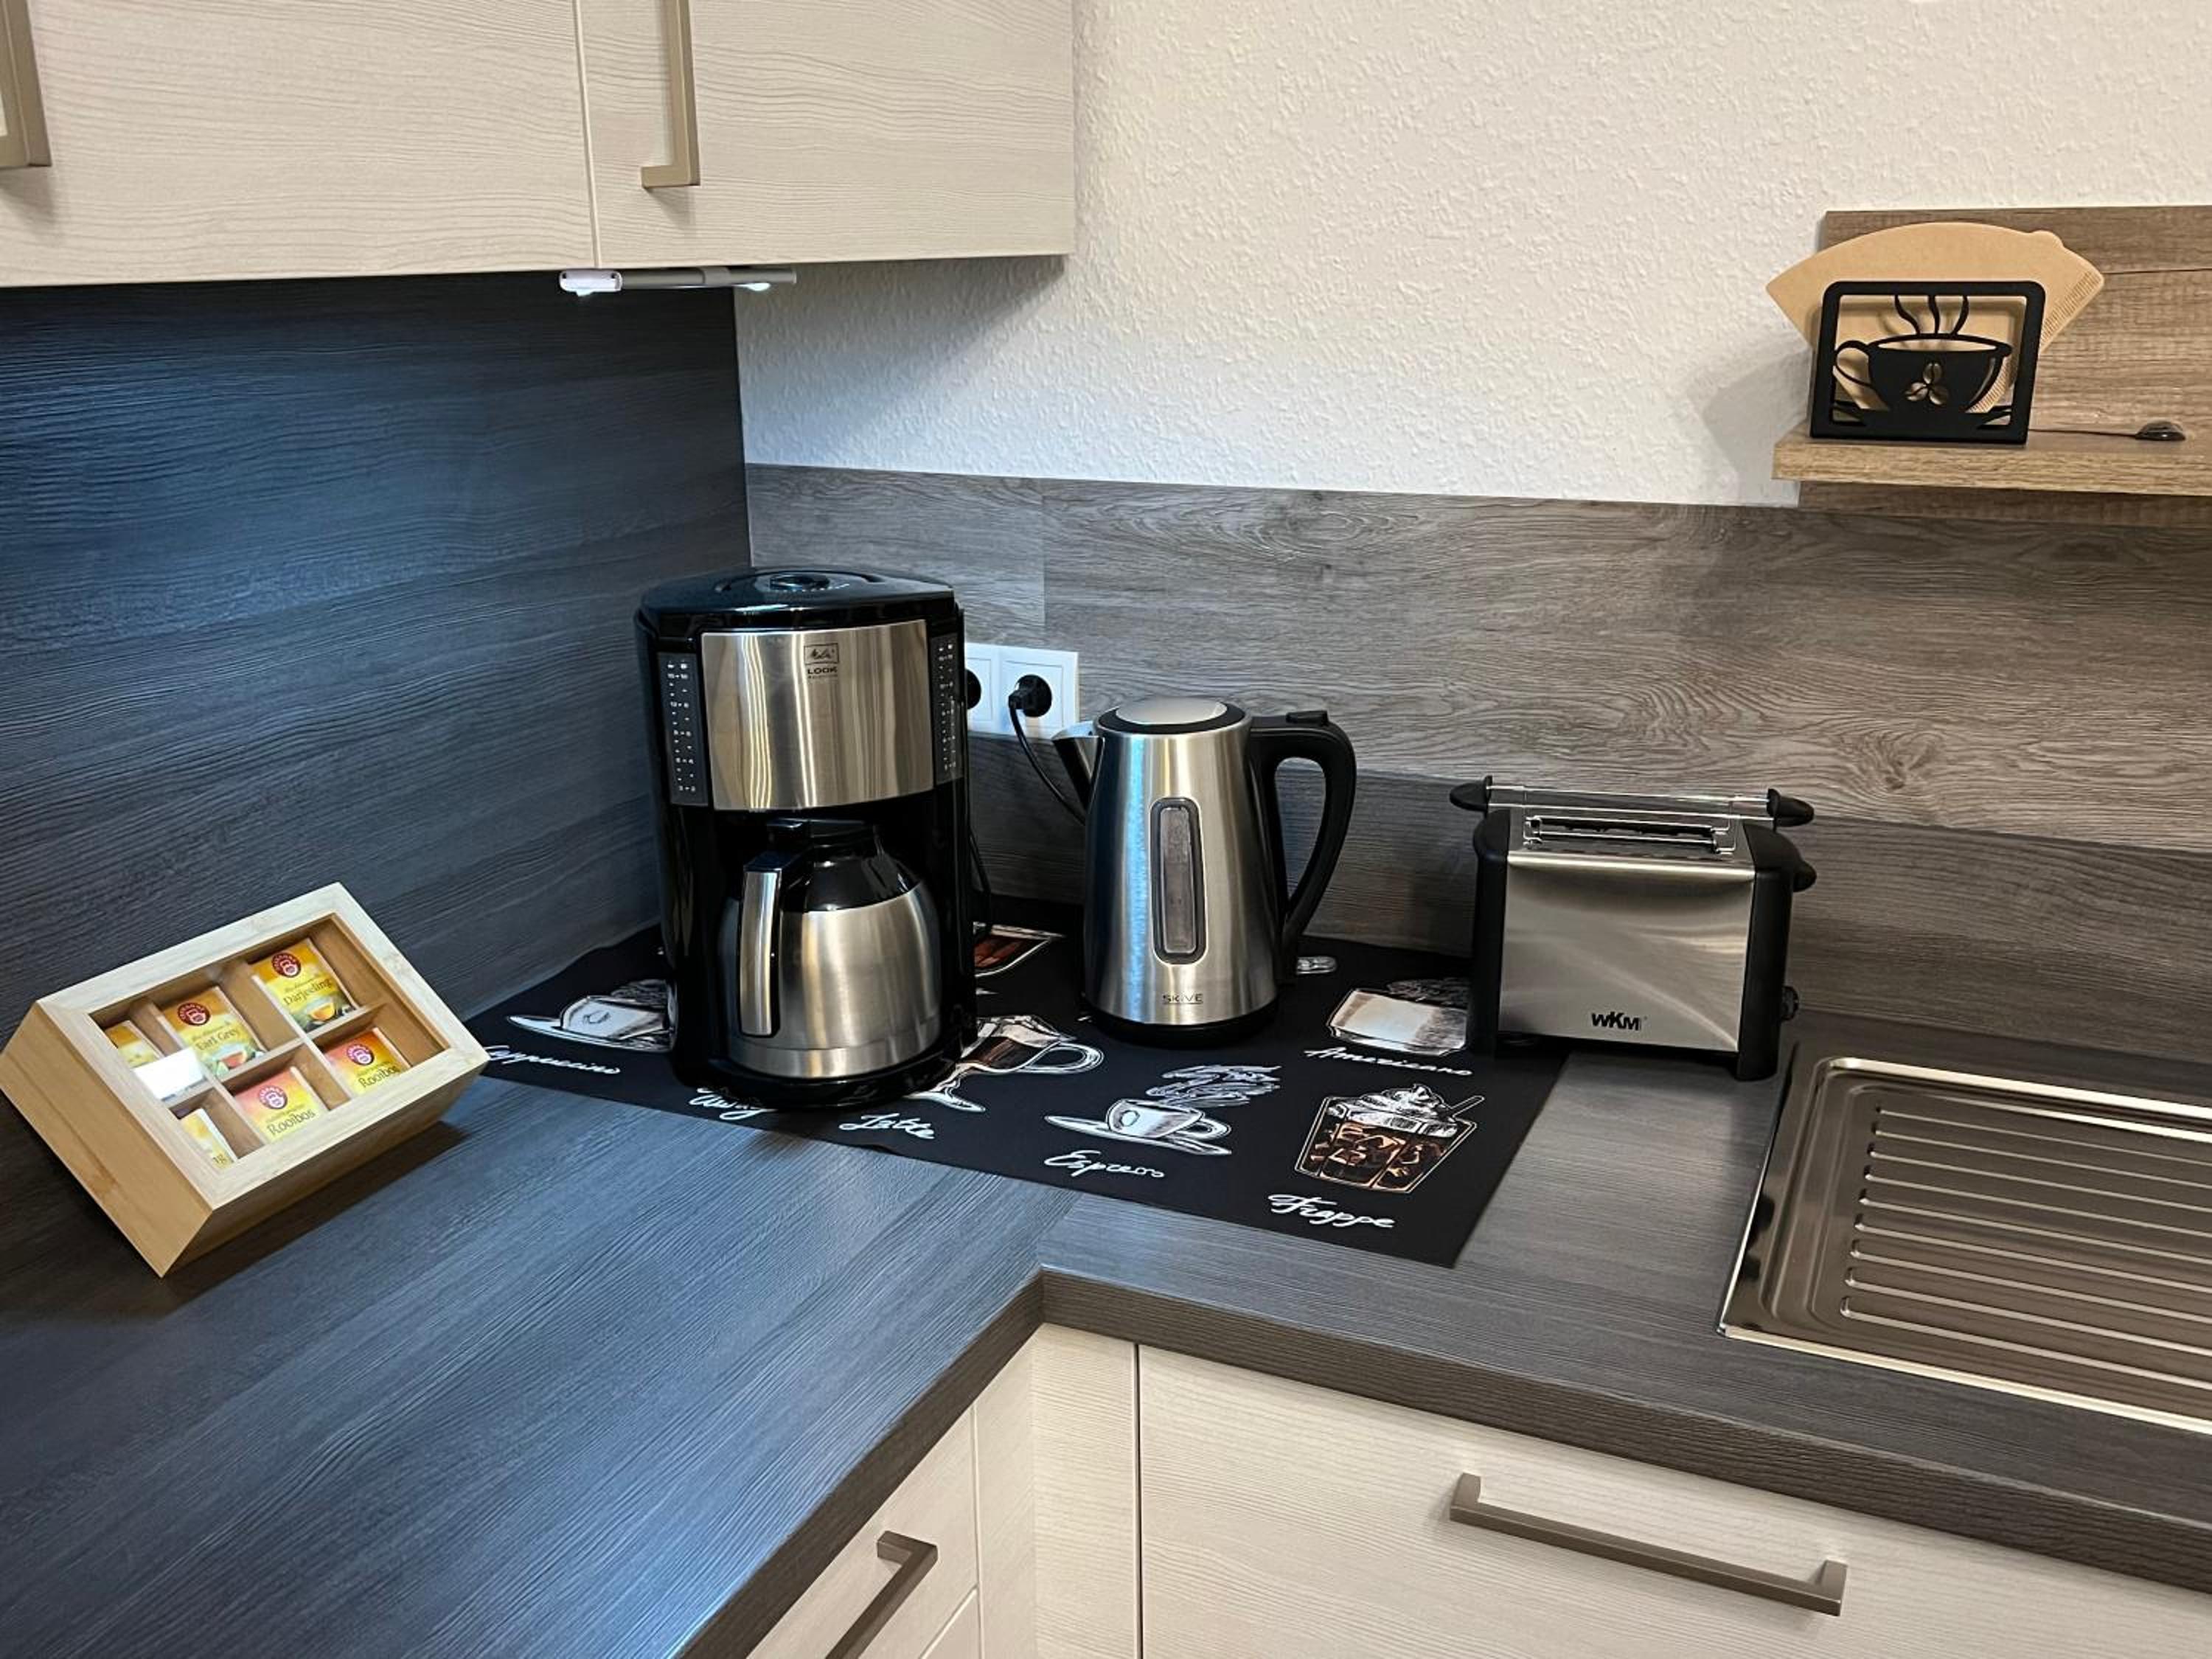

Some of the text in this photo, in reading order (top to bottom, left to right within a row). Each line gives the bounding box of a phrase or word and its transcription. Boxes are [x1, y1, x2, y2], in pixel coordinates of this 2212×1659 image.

[807, 666, 838, 675] LOOK
[266, 1108, 316, 1136] Rooibos
[839, 1113, 935, 1139] Latte
